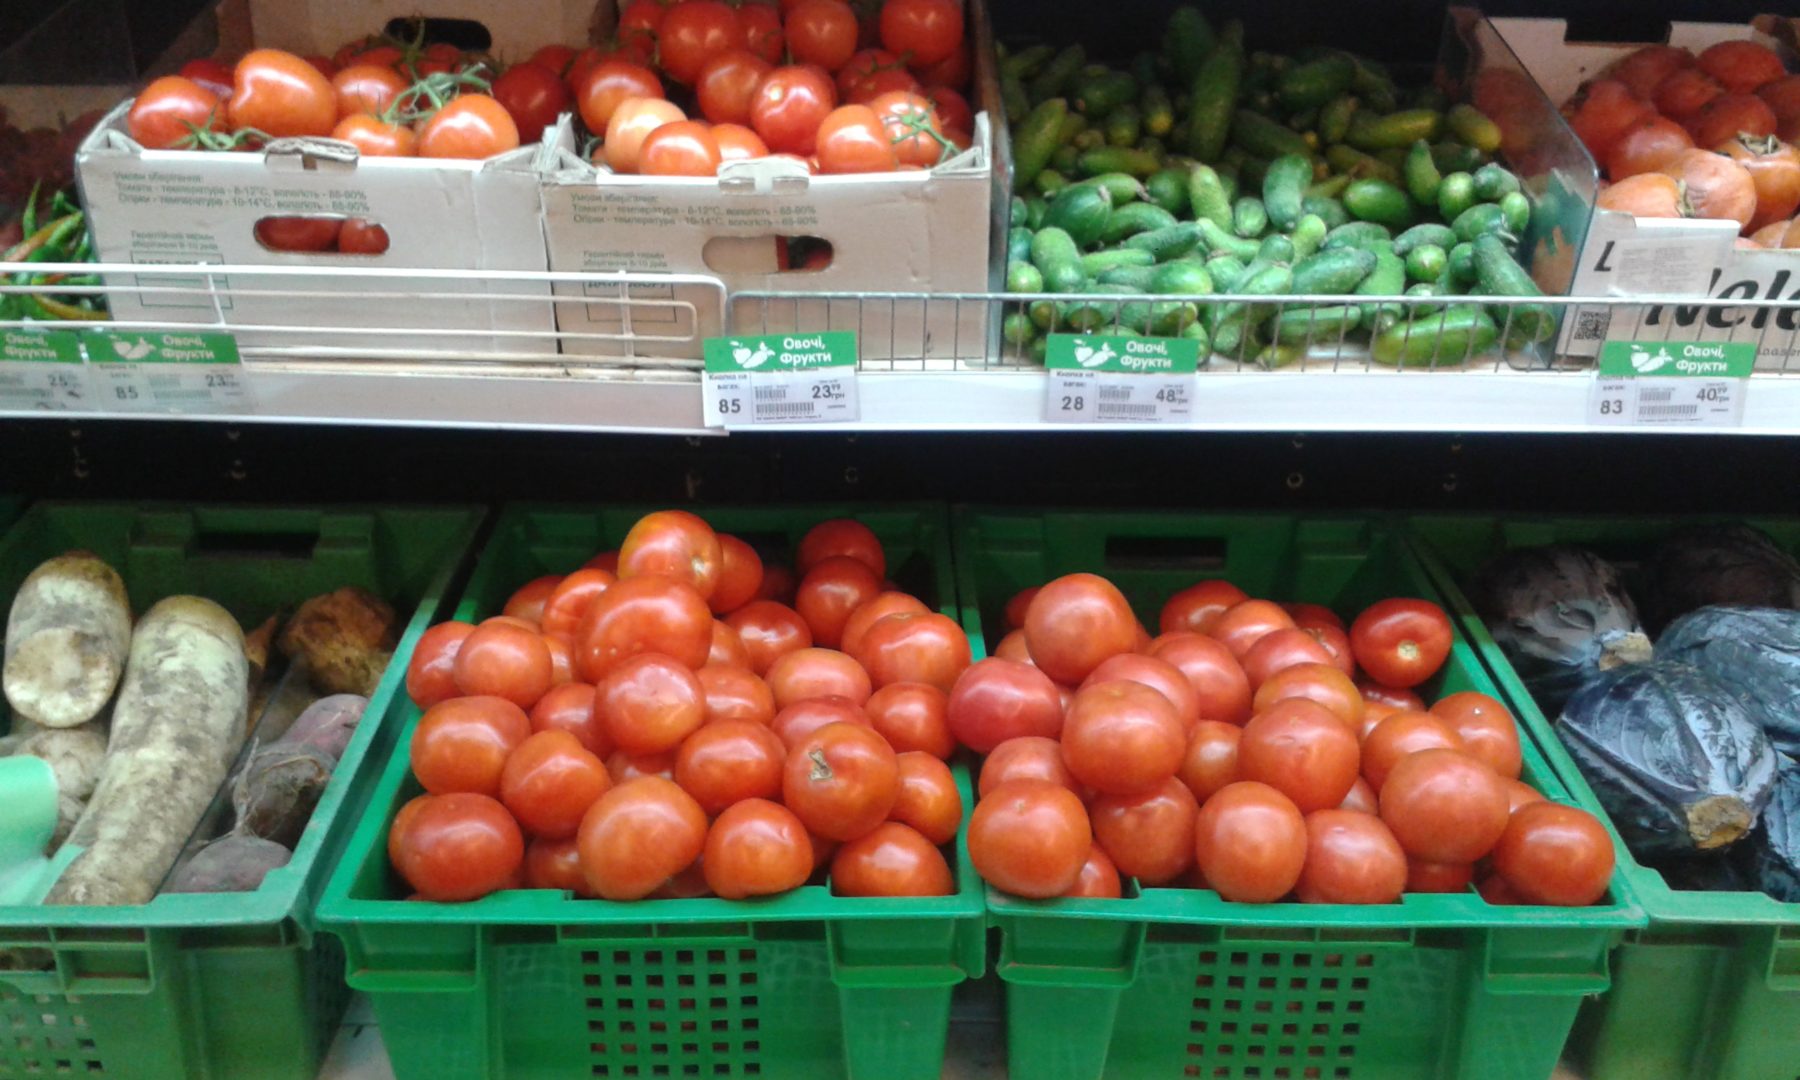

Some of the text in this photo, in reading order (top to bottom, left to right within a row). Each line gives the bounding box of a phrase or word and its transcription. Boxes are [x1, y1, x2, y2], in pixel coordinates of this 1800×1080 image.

[161, 185, 225, 197] температура
[160, 195, 223, 208] температура
[617, 206, 679, 216] температура
[614, 216, 676, 227] температура
[163, 333, 207, 349] Овочі,
[783, 335, 825, 350] Овочі,
[1126, 340, 1168, 355] Овочі,
[5, 346, 57, 360] Фрукти
[160, 347, 215, 361] Фрукти
[780, 351, 832, 366] Фрукти
[1683, 345, 1724, 358] Овочі,
[1120, 355, 1172, 369] Фрукти
[1676, 360, 1728, 374] Фрукти
[1155, 388, 1176, 402] 48
[1696, 387, 1717, 401] 40
[719, 398, 741, 414] 85
[1061, 396, 1084, 411] 28
[1600, 399, 1623, 414] 83
